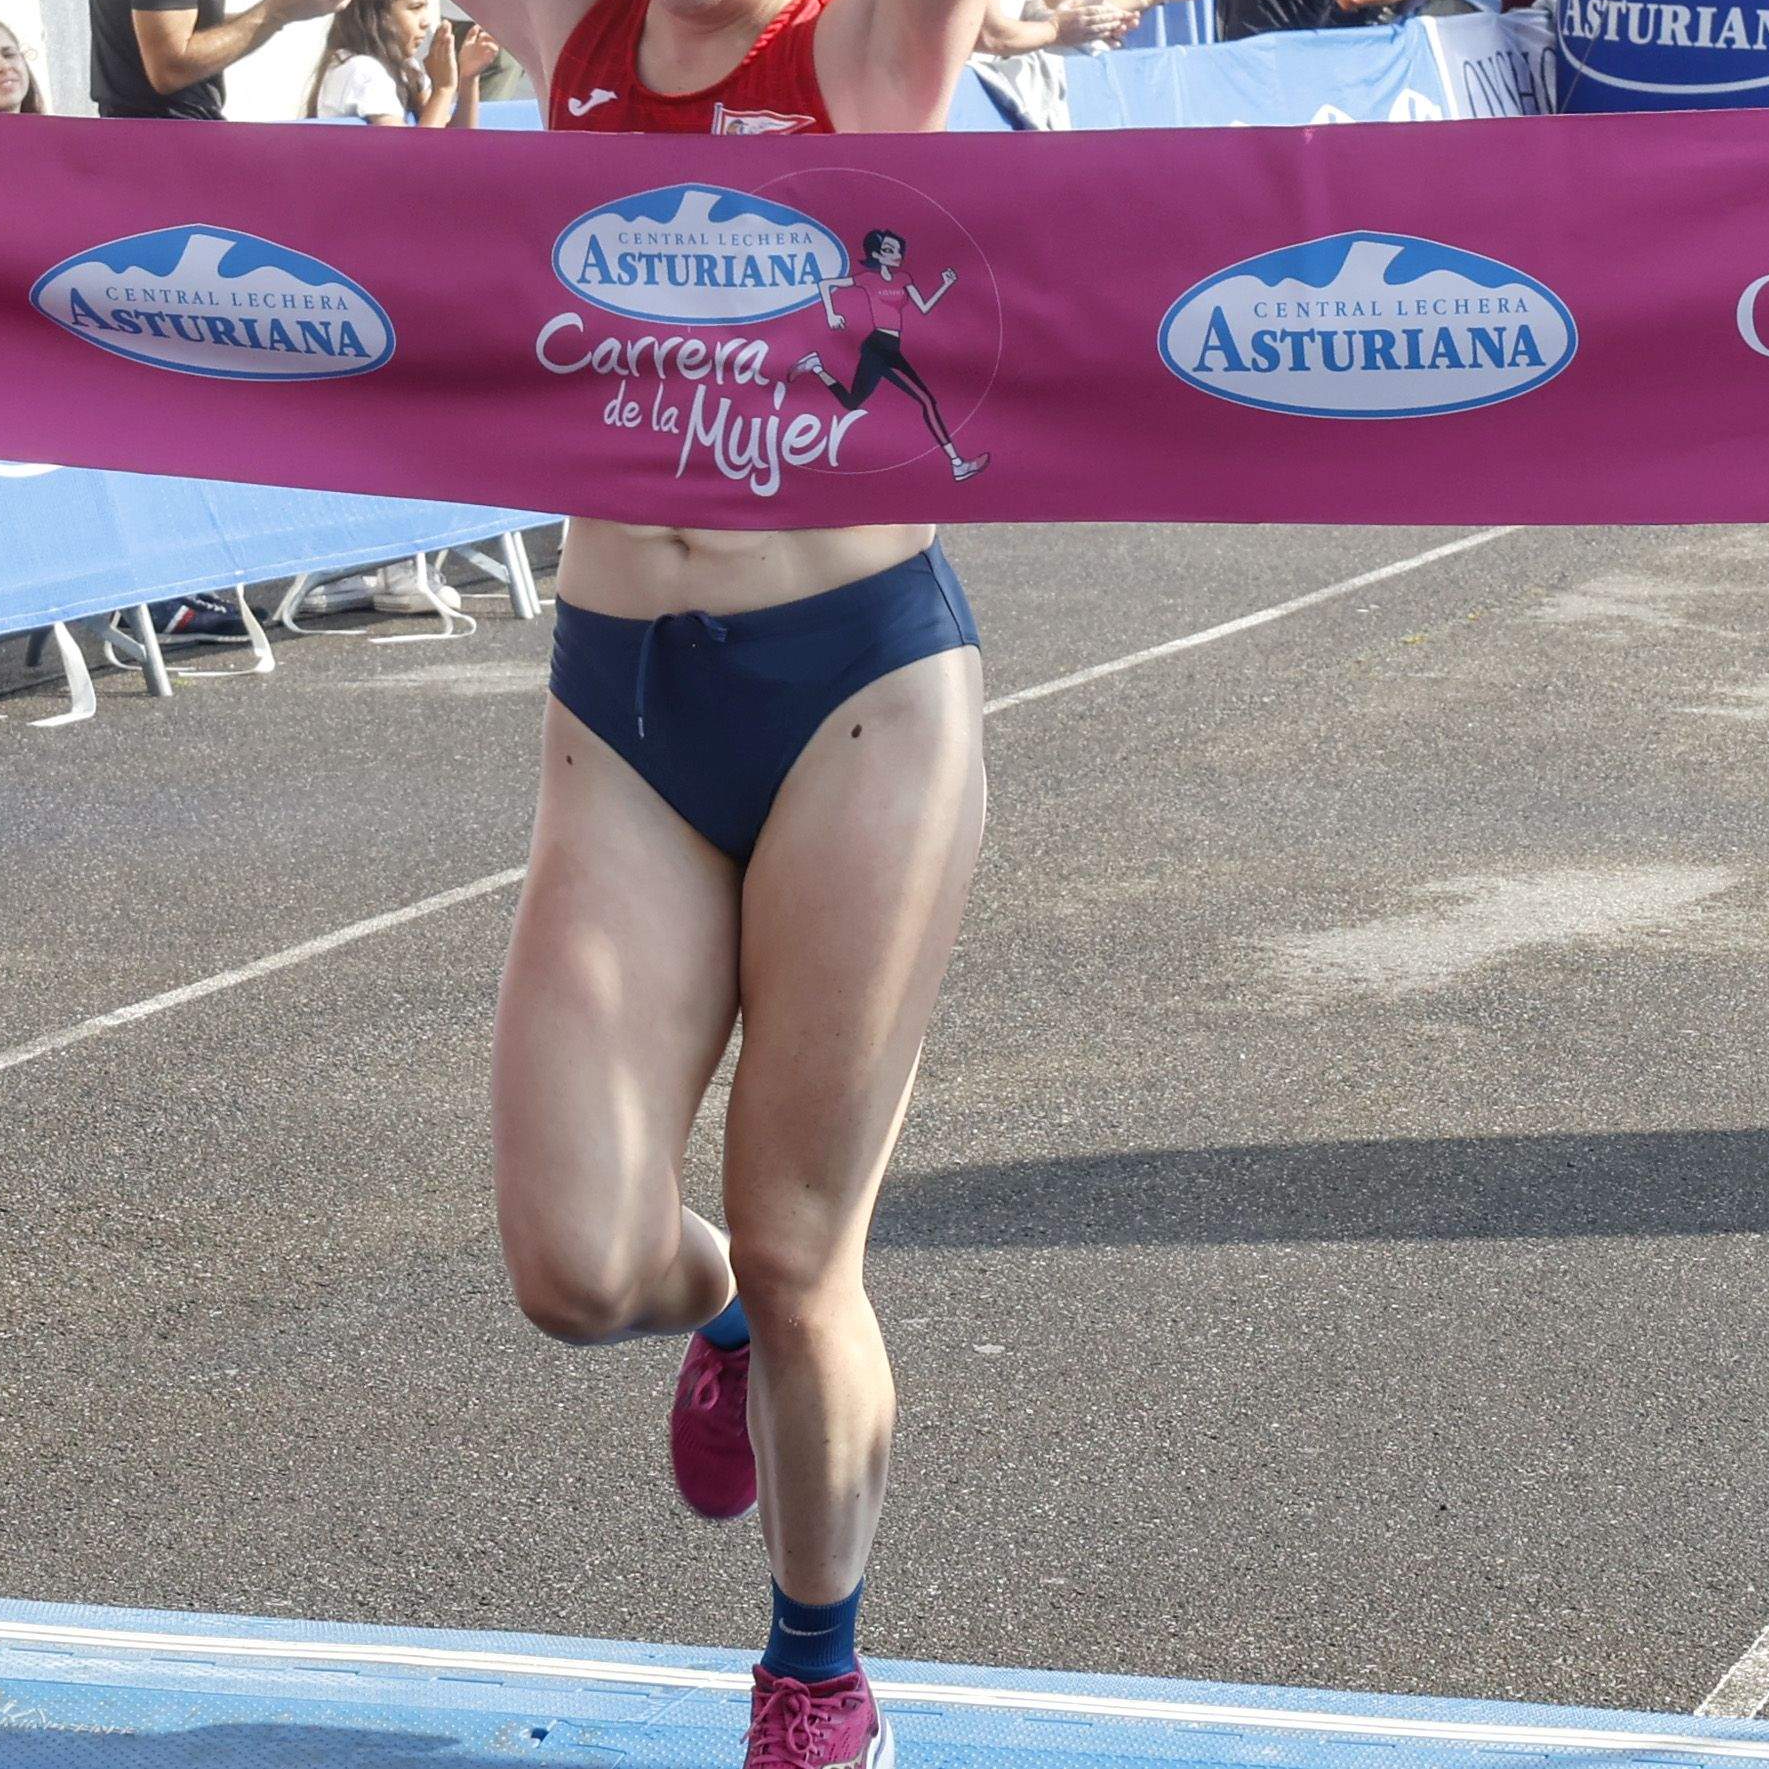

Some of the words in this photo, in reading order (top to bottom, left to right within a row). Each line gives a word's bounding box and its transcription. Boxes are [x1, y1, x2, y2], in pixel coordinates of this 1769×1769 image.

[577, 234, 826, 288] ASTURIANA
[618, 232, 710, 246] CENTRAL
[718, 231, 813, 246] LECHERA
[70, 287, 371, 359] ASTURIANA
[105, 286, 220, 306] CENTRAL
[231, 292, 349, 311] LECHERA
[1253, 301, 1385, 320] CENTRAL
[1396, 296, 1530, 316] LECHERA
[535, 312, 770, 385] Carrera
[1192, 304, 1547, 374] ASTURIANA
[603, 379, 643, 428] de
[651, 382, 680, 434] la
[675, 381, 870, 497] Mujer
